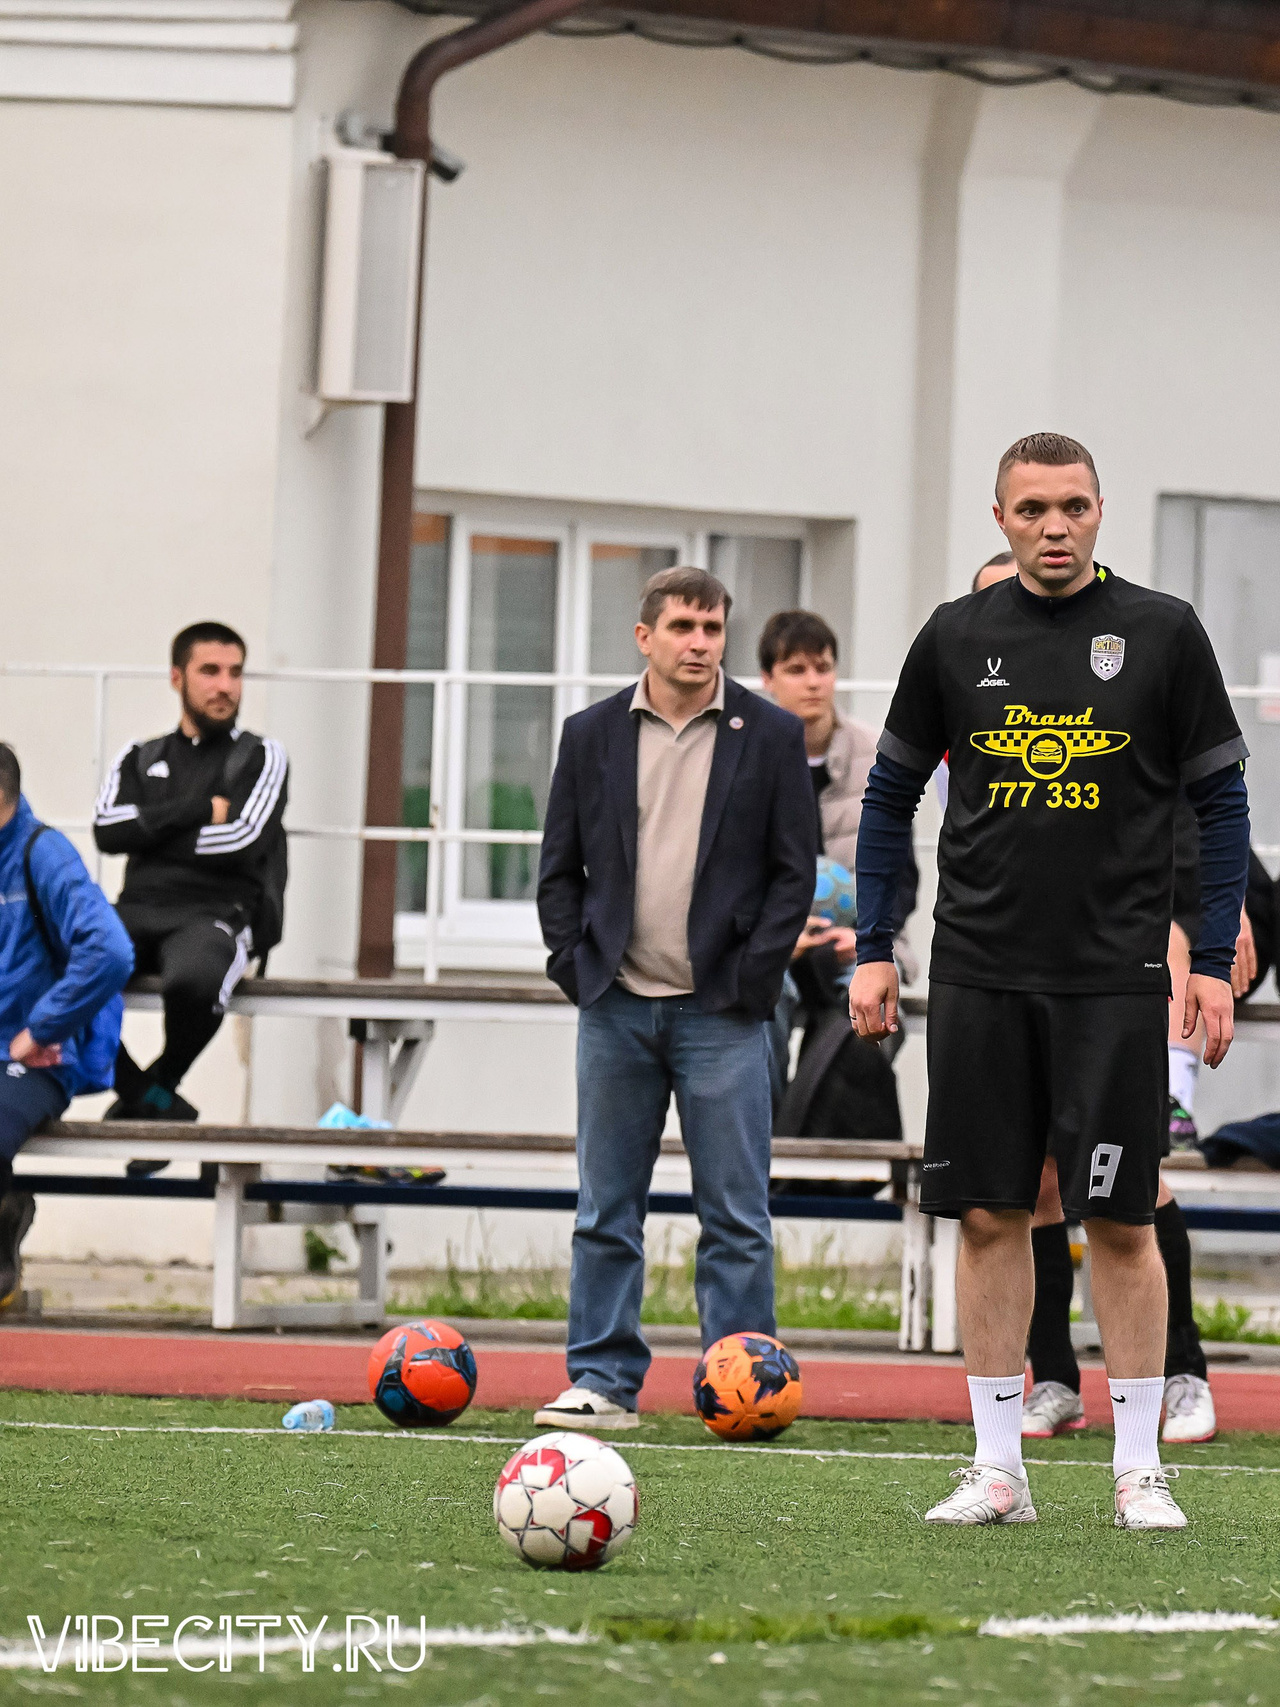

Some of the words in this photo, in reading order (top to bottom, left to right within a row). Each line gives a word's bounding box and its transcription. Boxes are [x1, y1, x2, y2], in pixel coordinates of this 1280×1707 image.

[976, 677, 1010, 688] JÖGEL
[1003, 704, 1094, 726] Brand
[988, 781, 1036, 809] 777
[1046, 782, 1100, 810] 333
[1088, 1143, 1123, 1200] 9
